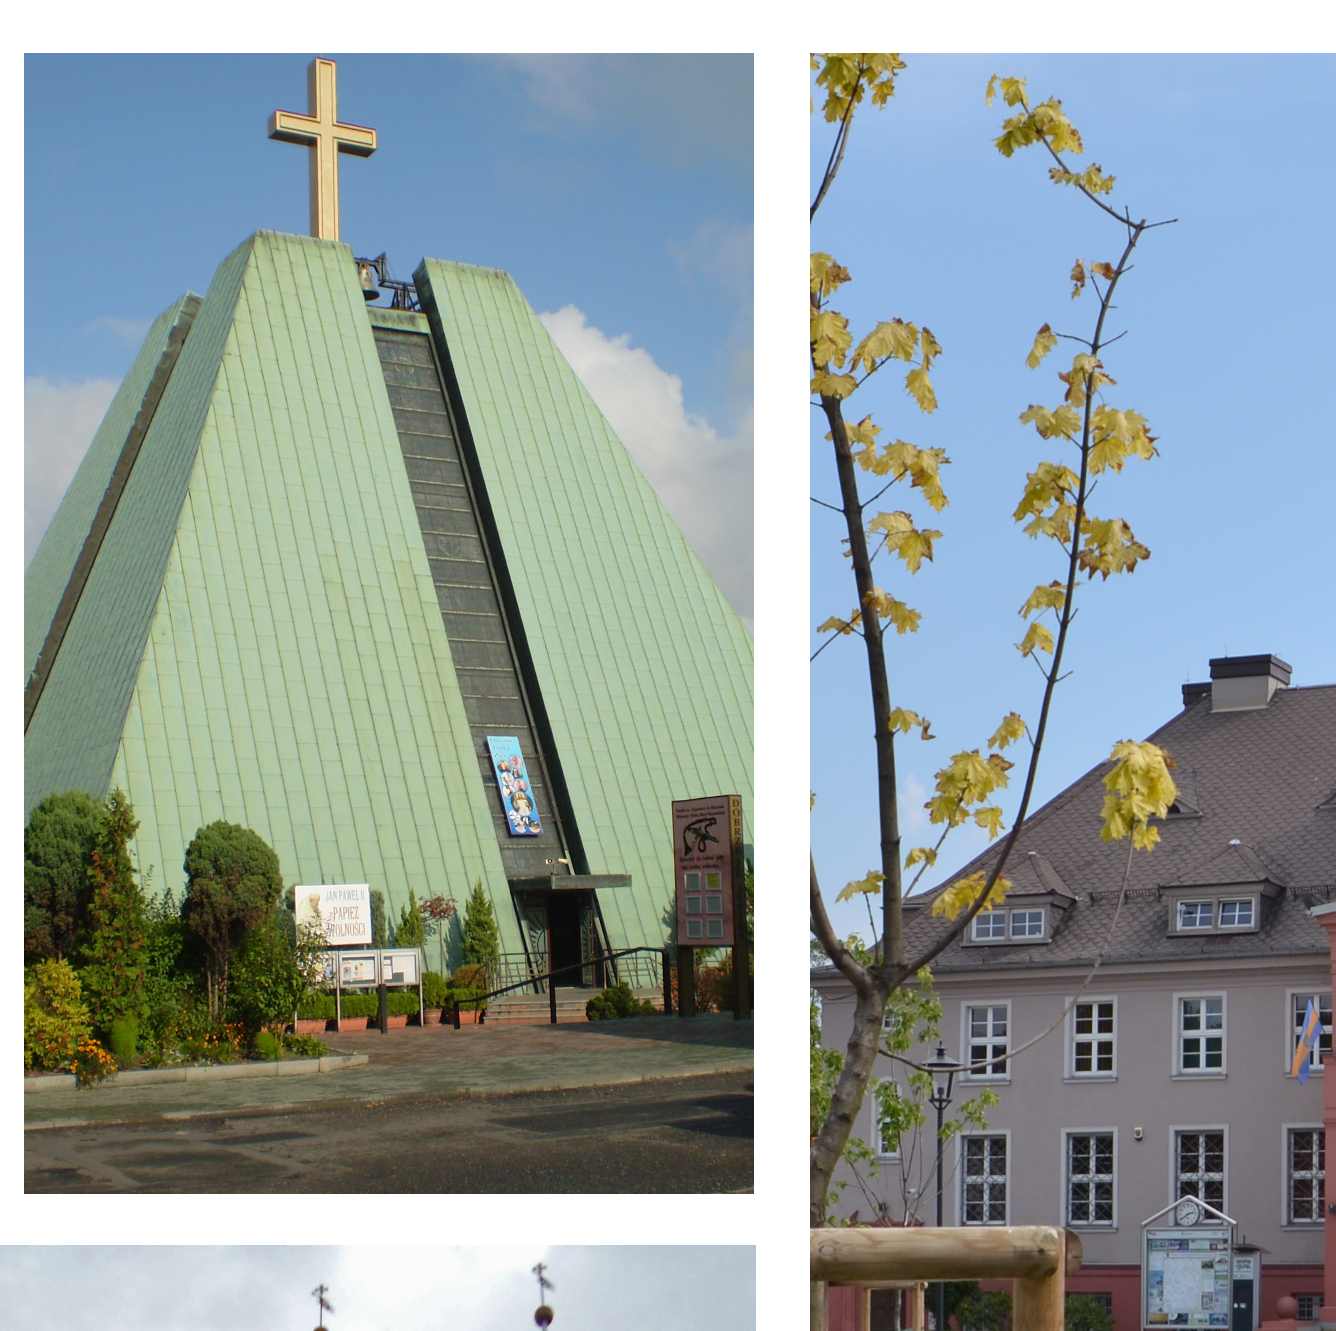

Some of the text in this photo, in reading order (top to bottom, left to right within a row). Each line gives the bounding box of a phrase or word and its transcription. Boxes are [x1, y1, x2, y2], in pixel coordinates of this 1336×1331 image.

[326, 890, 337, 901] JAN
[338, 889, 359, 901] PAWEŁ
[333, 904, 359, 920] PAPIEŻ
